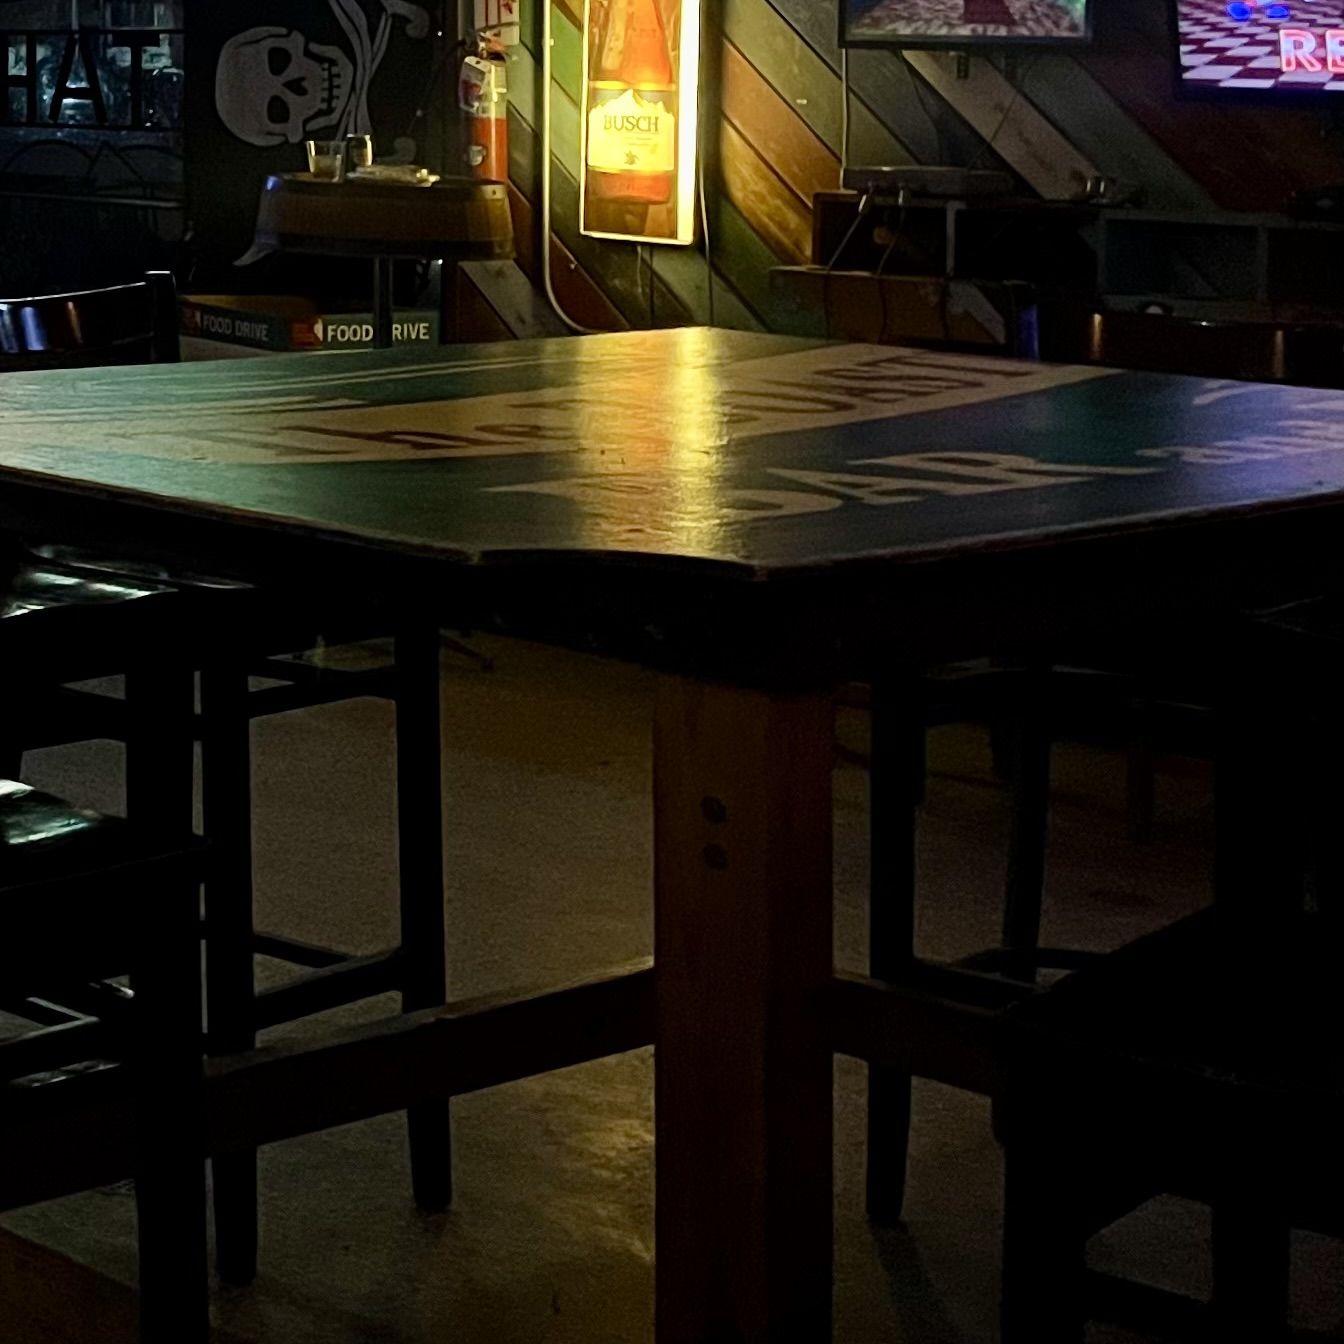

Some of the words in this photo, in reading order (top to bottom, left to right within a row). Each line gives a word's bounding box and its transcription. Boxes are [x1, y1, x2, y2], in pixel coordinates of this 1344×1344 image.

[603, 115, 659, 132] BUSCH
[202, 314, 232, 335] FOOD
[234, 320, 269, 342] DRIVE
[327, 324, 374, 342] FOOD
[392, 322, 430, 341] RIVE
